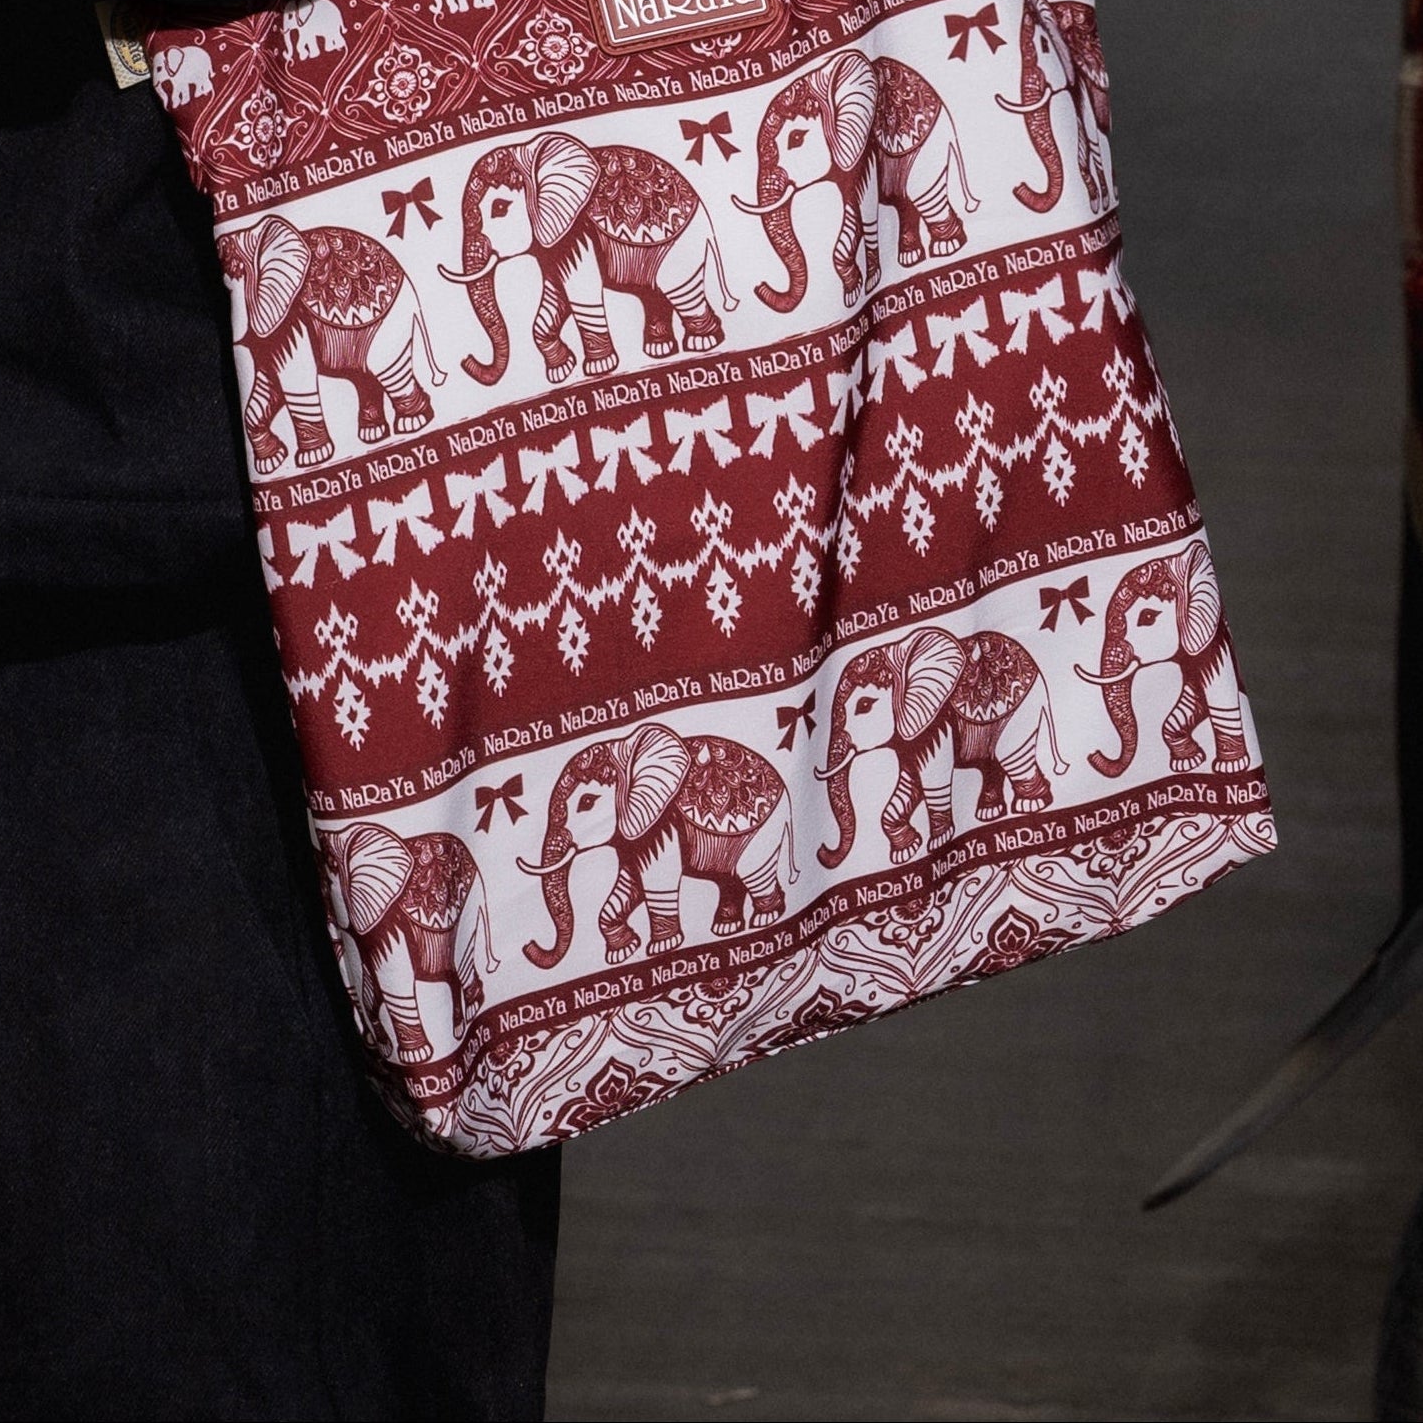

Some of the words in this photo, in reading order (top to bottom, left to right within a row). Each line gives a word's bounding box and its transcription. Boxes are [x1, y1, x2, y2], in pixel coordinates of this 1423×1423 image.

[245, 172, 300, 205] NaRaYa
[304, 147, 376, 186] NaRaYa
[384, 122, 455, 159] NaRaYa
[459, 103, 527, 135] NaRaYa
[532, 87, 606, 119] NaRaYa
[613, 77, 683, 102] NaRaYa
[688, 59, 763, 91] NaRaYa
[769, 27, 832, 72] NaRaYa
[288, 469, 363, 507] NaRaYa
[366, 445, 439, 484] NaRaYa
[446, 417, 517, 457] NaRaYa
[520, 394, 588, 432] NaRaYa
[591, 378, 661, 411] NaRaYa
[667, 362, 742, 394] NaRaYa
[748, 344, 824, 379] NaRaYa
[829, 317, 868, 355] NaRaYa
[872, 287, 925, 325] NaRaYa
[929, 262, 999, 298] NaRaYa
[1004, 239, 1076, 275] NaRaYa
[339, 776, 417, 810] NaRaYa
[421, 746, 476, 790] NaRaYa
[484, 717, 554, 757] NaRaYa
[560, 698, 629, 734] NaRaYa
[634, 677, 702, 712] NaRaYa
[709, 663, 786, 693] NaRaYa
[791, 632, 833, 677] NaRaYa
[836, 603, 899, 640] NaRaYa
[908, 578, 975, 615] NaRaYa
[978, 549, 1040, 589] NaRaYa
[1045, 529, 1117, 563] NaRaYa
[1122, 510, 1187, 544] NaRaYa
[404, 1064, 464, 1099] NaRaYa
[498, 997, 567, 1033] NaRaYa
[573, 974, 644, 1010] NaRaYa
[651, 953, 721, 987] NaRaYa
[728, 932, 793, 966] NaRaYa
[799, 892, 848, 940] NaRaYa
[855, 873, 923, 907] NaRaYa
[931, 840, 989, 881] NaRaYa
[995, 822, 1066, 854] NaRaYa
[1074, 799, 1140, 835] NaRaYa
[1146, 783, 1218, 810] NaRaYa
